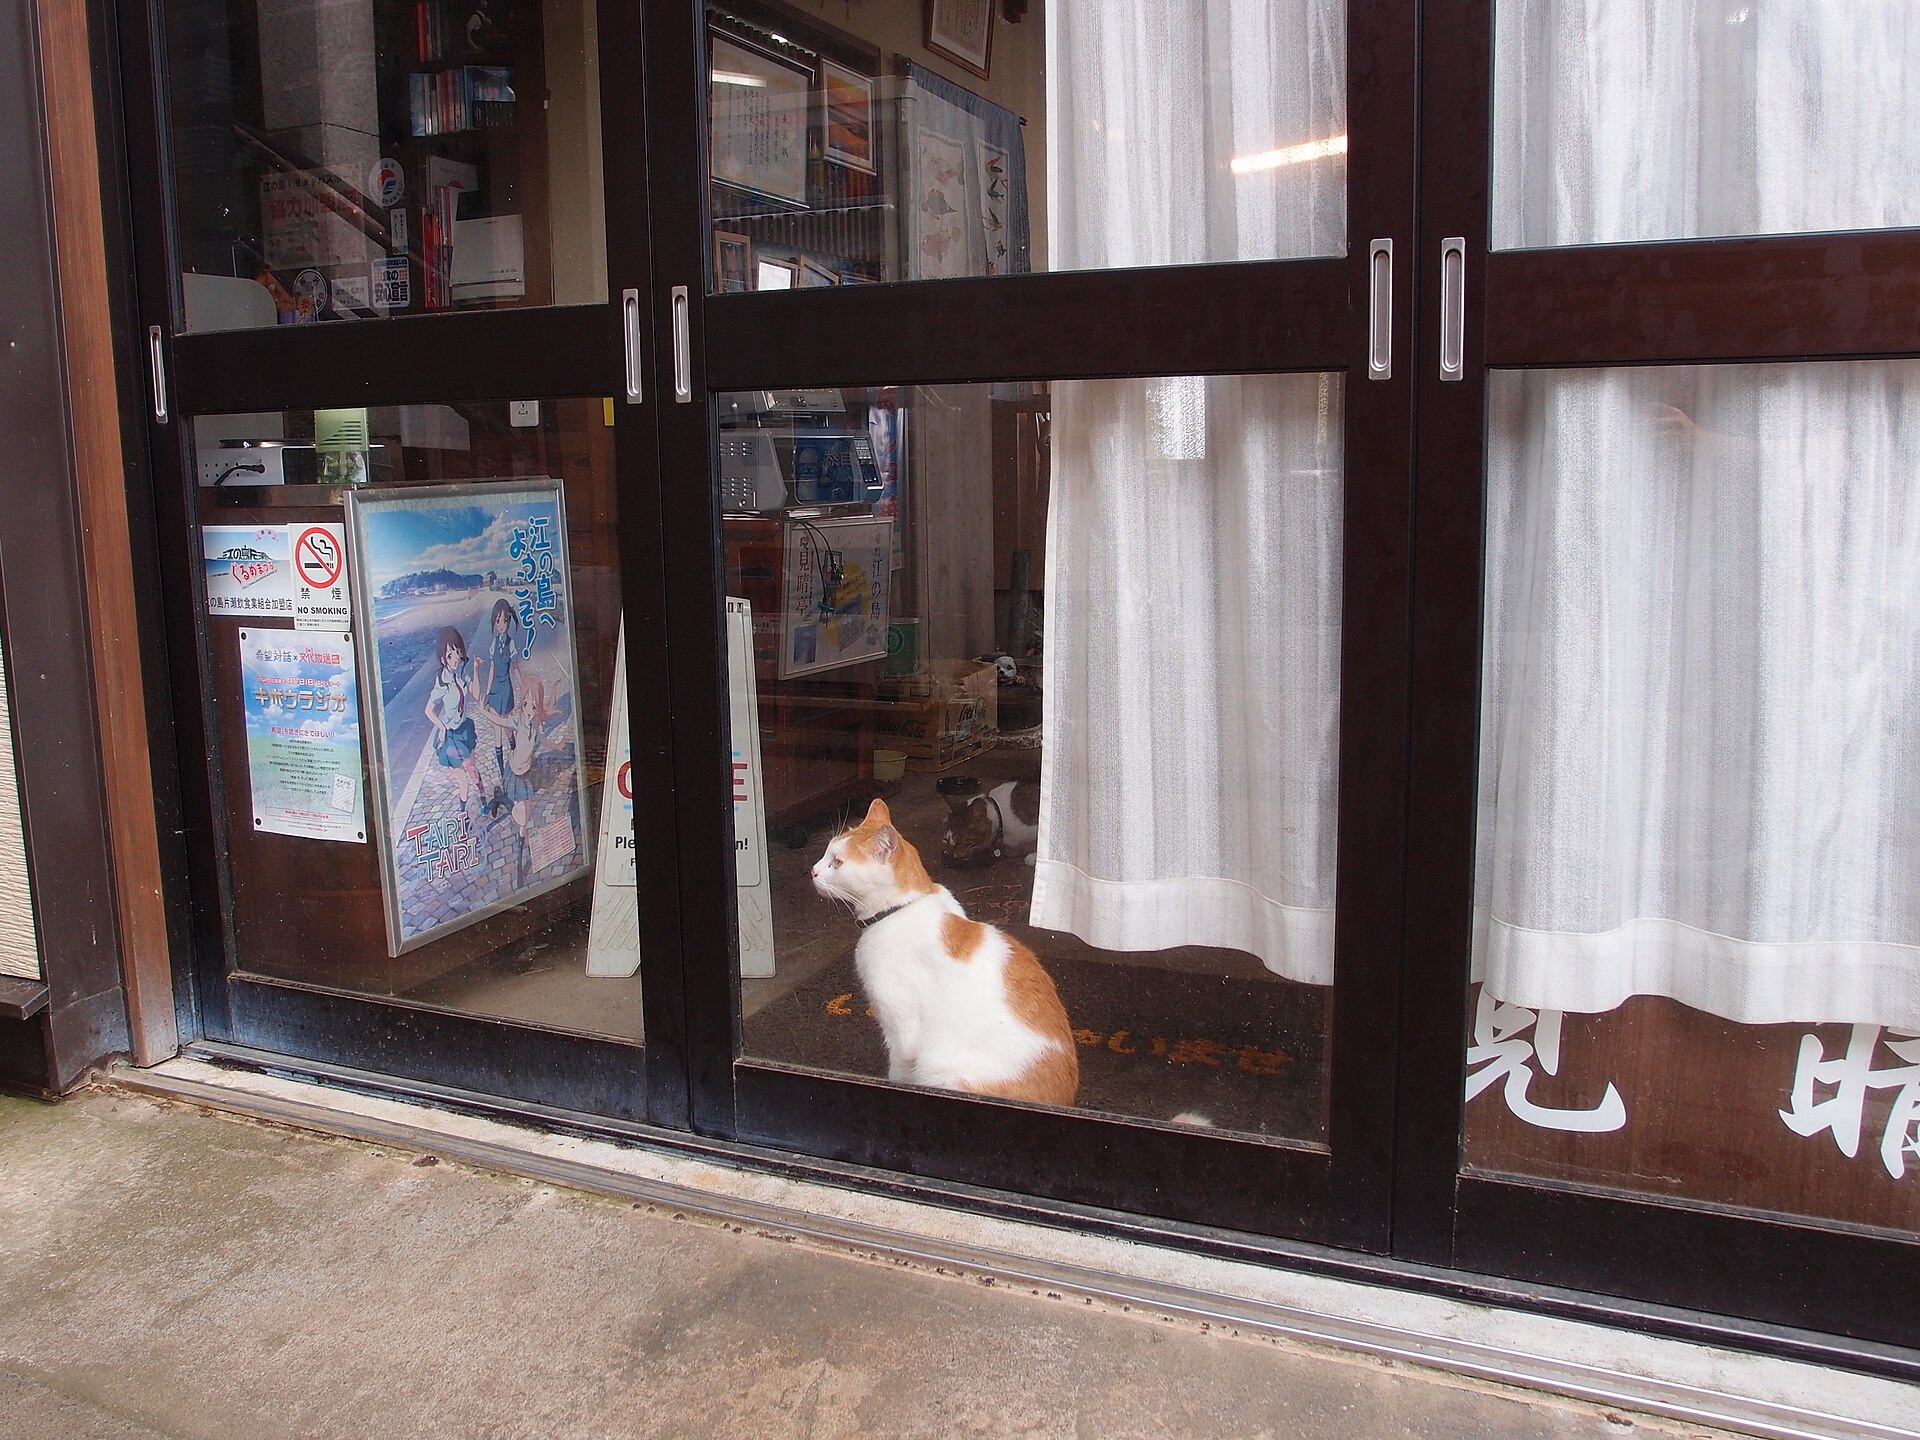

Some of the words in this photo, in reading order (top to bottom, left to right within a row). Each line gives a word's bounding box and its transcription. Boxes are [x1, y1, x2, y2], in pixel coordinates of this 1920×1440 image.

[509, 527, 536, 660] ようこそ!
[529, 516, 556, 629] 江の島へ
[208, 596, 293, 611] の島片瀬飲食業組合加盟店
[297, 606, 309, 614] NO
[311, 607, 348, 615] SMOKING
[255, 687, 347, 712] キボウラジオ
[406, 812, 468, 856] TARI
[418, 838, 481, 883] TARI
